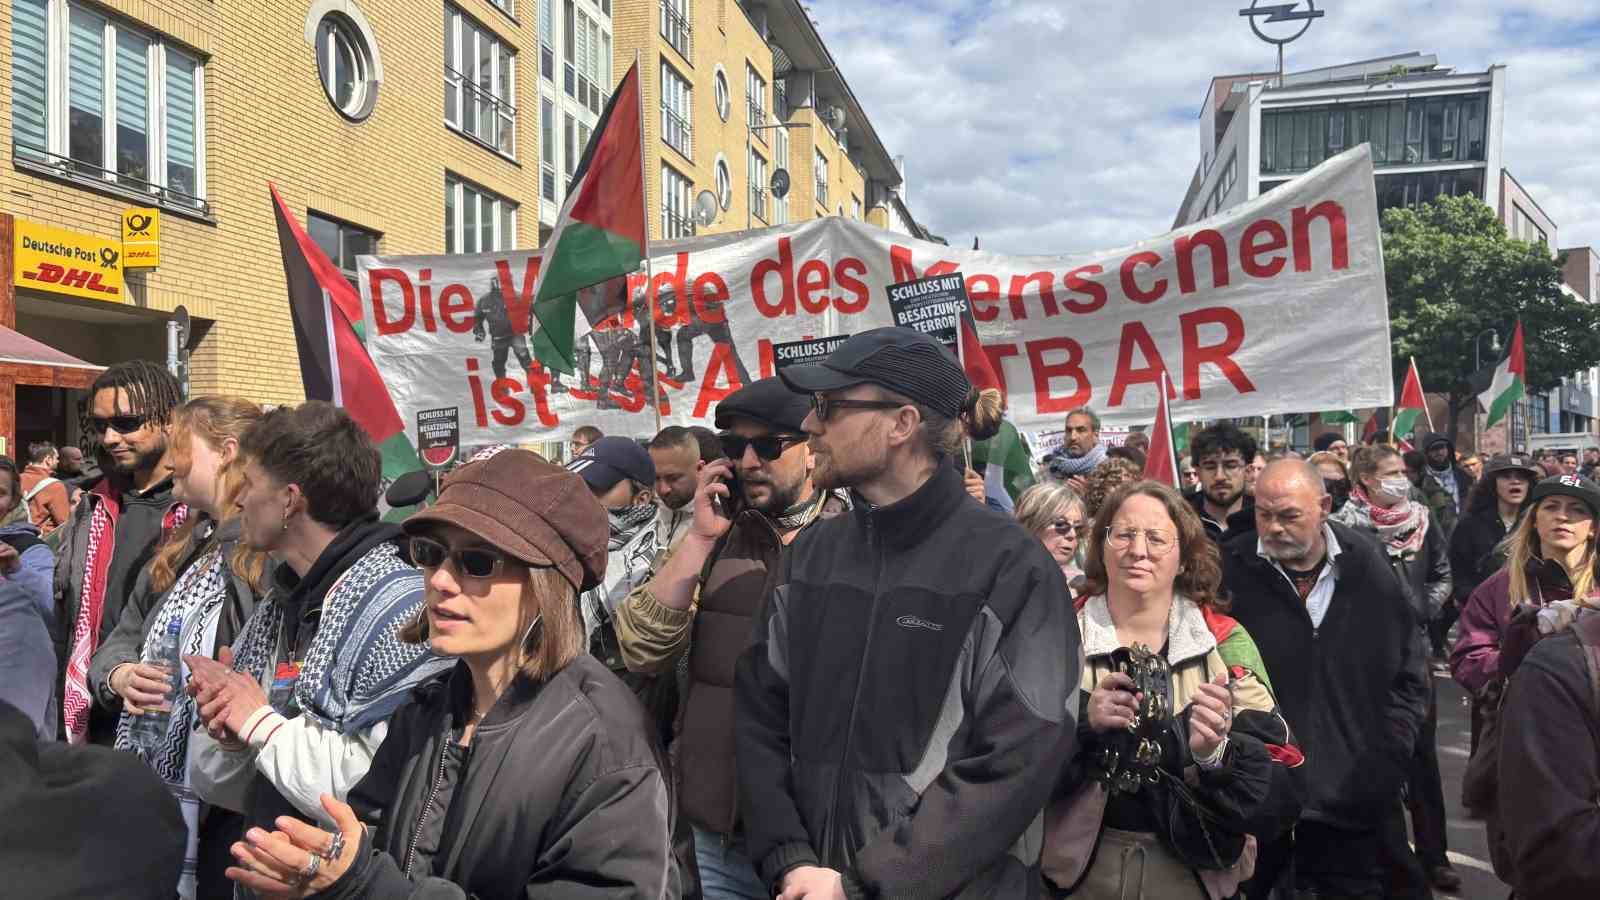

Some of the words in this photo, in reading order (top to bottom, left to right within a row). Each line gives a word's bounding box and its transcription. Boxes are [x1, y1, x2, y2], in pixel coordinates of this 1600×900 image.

[23, 236, 72, 258] Deutsche
[74, 247, 96, 263] Post
[37, 262, 106, 292] DHL
[368, 267, 474, 336] Die
[750, 237, 870, 318] des
[891, 280, 940, 301] SCHLUSS
[941, 277, 960, 291] MIT
[777, 342, 825, 360] SCHLUSS
[466, 357, 559, 428] ist
